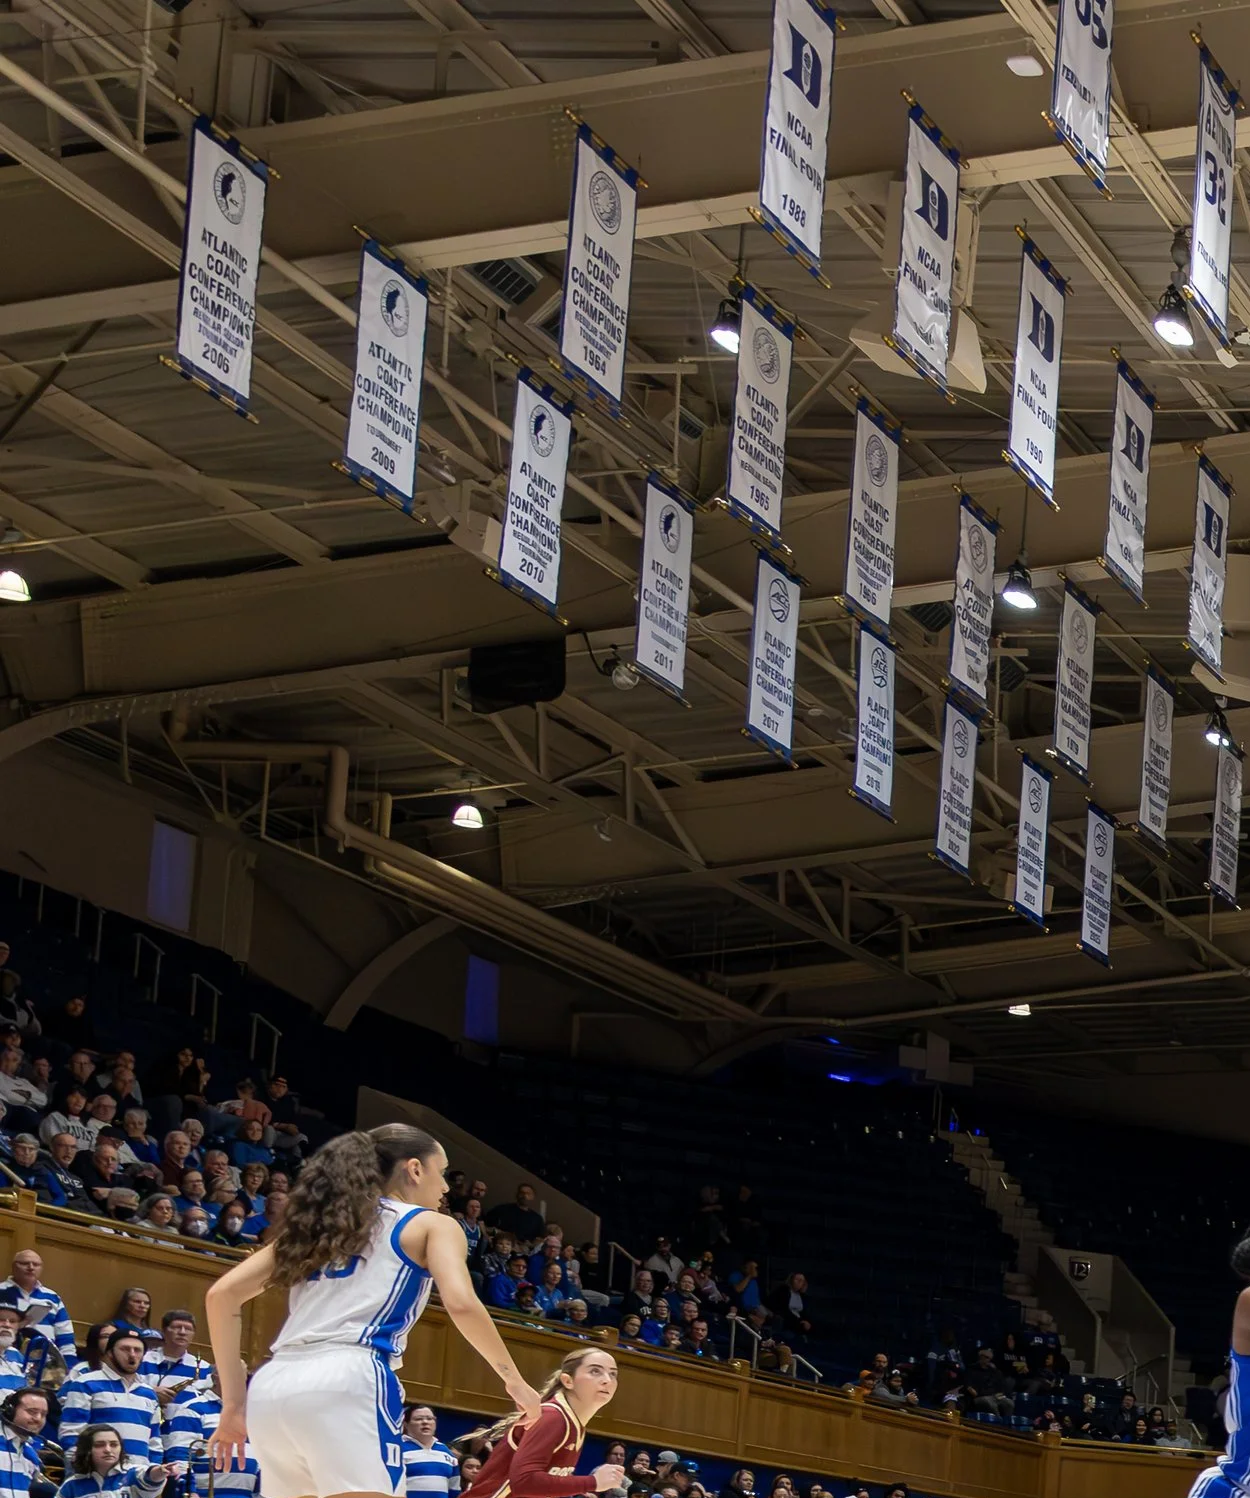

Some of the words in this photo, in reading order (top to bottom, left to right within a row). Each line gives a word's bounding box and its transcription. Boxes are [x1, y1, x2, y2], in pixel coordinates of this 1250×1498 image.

[770, 127, 798, 169] FINAL
[787, 111, 812, 150] NCAA
[782, 194, 807, 227] 1988
[201, 228, 248, 274] ATLANTIC
[583, 233, 621, 279] ATLANTIC
[917, 245, 941, 280] NCAA
[207, 254, 241, 288] COAST
[587, 259, 614, 293] COAST
[189, 262, 256, 321] CONFERENCE
[571, 267, 626, 326] CONFERENCE
[190, 286, 251, 340] CHAMPIONS
[573, 289, 622, 344] CHAMPIONS
[202, 343, 229, 374] 2006
[368, 341, 413, 382] ATLANTIC
[583, 345, 606, 376] 1964
[377, 365, 406, 396] COAST
[1030, 368, 1047, 399] NCAA
[357, 373, 416, 427] CONFERENCE
[746, 384, 779, 422] ATLANTIC
[1017, 384, 1036, 414] FINAL
[357, 395, 413, 443] CHAMPIONS
[751, 407, 773, 436] COAST
[737, 415, 784, 464] CONFERENCE
[371, 447, 395, 475] 2009
[738, 435, 781, 481] CHAMPIONS
[520, 461, 557, 498] ATLANTIC
[527, 483, 550, 511] COAST
[509, 491, 560, 538] CONFERENCE
[750, 485, 770, 511] 1965
[861, 489, 889, 522] ATLANTIC
[510, 511, 557, 554] CHAMPIONS
[853, 518, 894, 561] CONFERENCE
[519, 558, 544, 583] 2010
[652, 559, 683, 591] ATLANTIC
[654, 650, 673, 672] 2011
[764, 630, 791, 658] ATLANTIC
[762, 713, 779, 734] 2017
